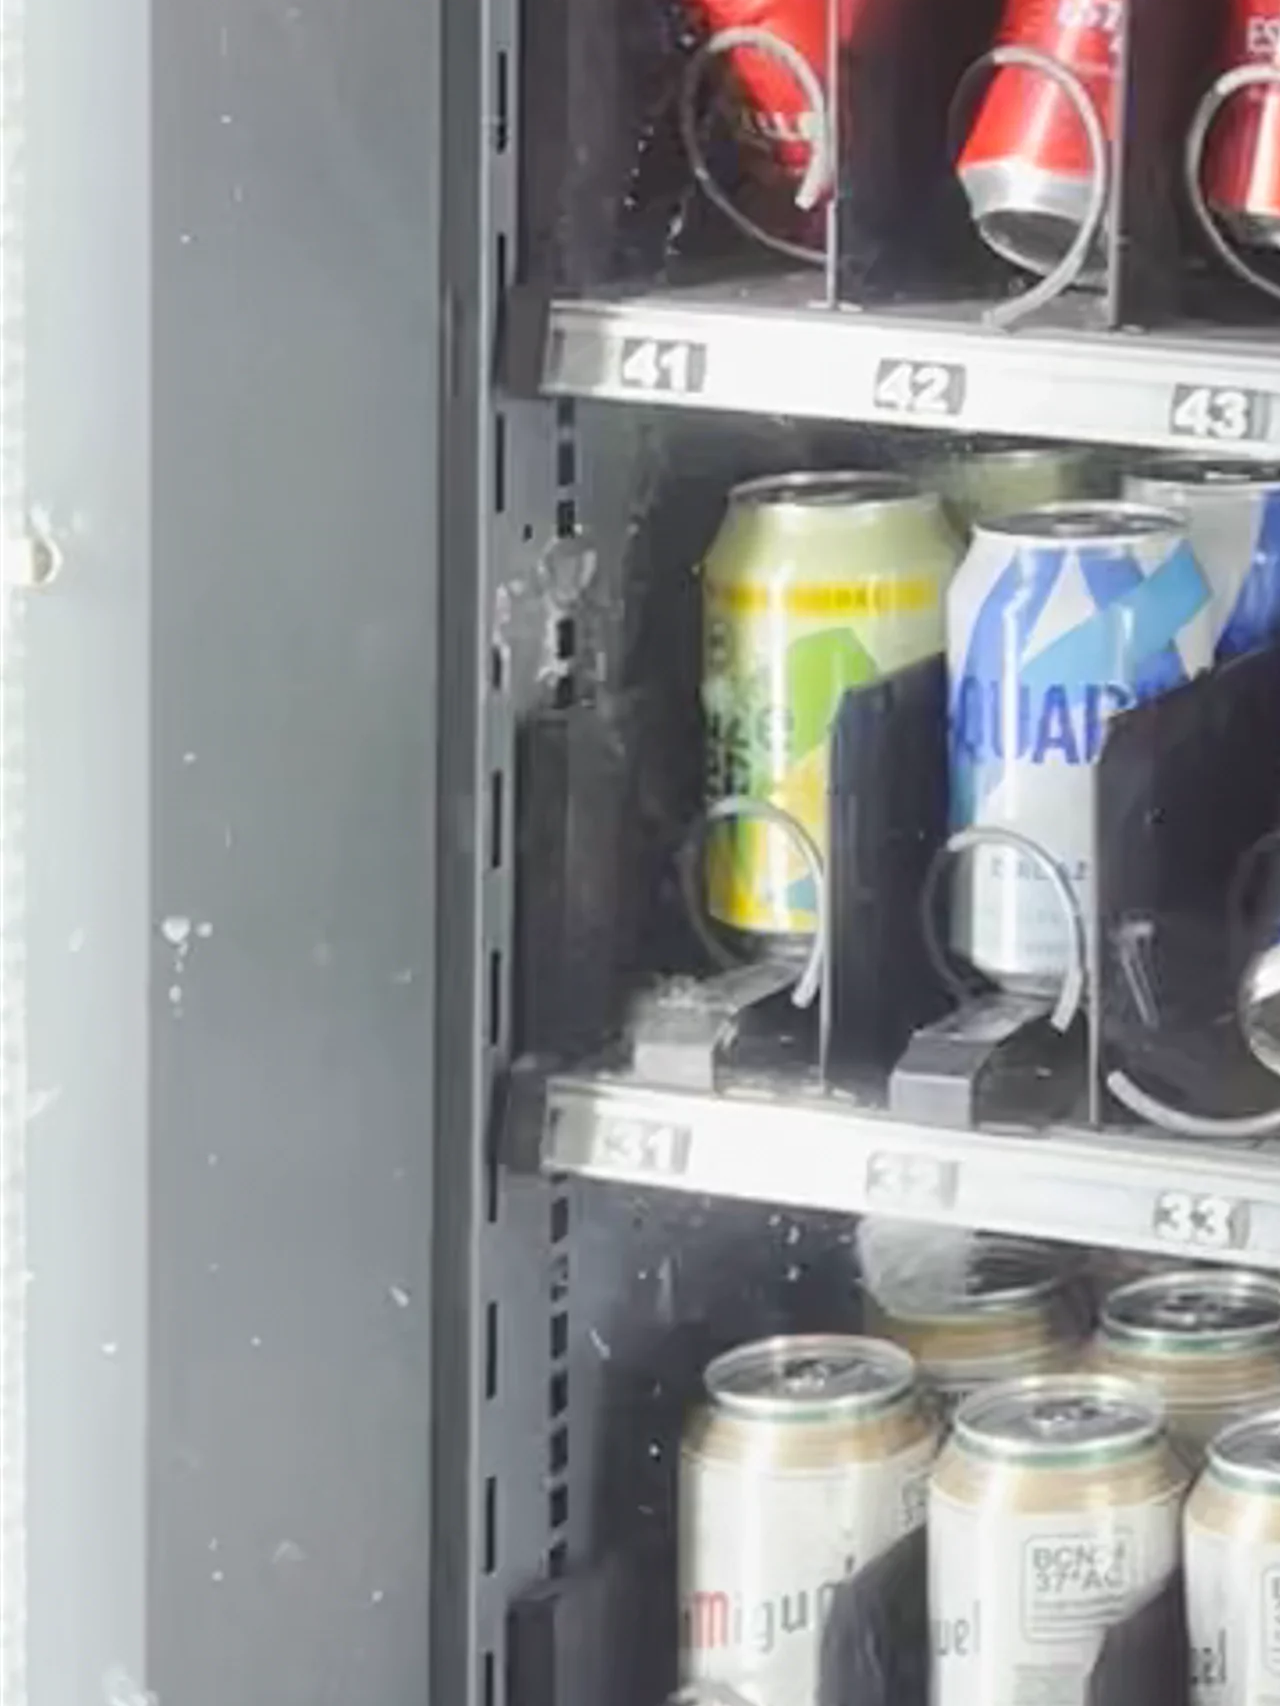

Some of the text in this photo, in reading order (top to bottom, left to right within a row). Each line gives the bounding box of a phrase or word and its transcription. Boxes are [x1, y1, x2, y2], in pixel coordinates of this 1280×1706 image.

[622, 342, 696, 390] 41
[877, 362, 953, 411] 42
[1172, 388, 1250, 436] 43
[1154, 1193, 1232, 1245] 33
